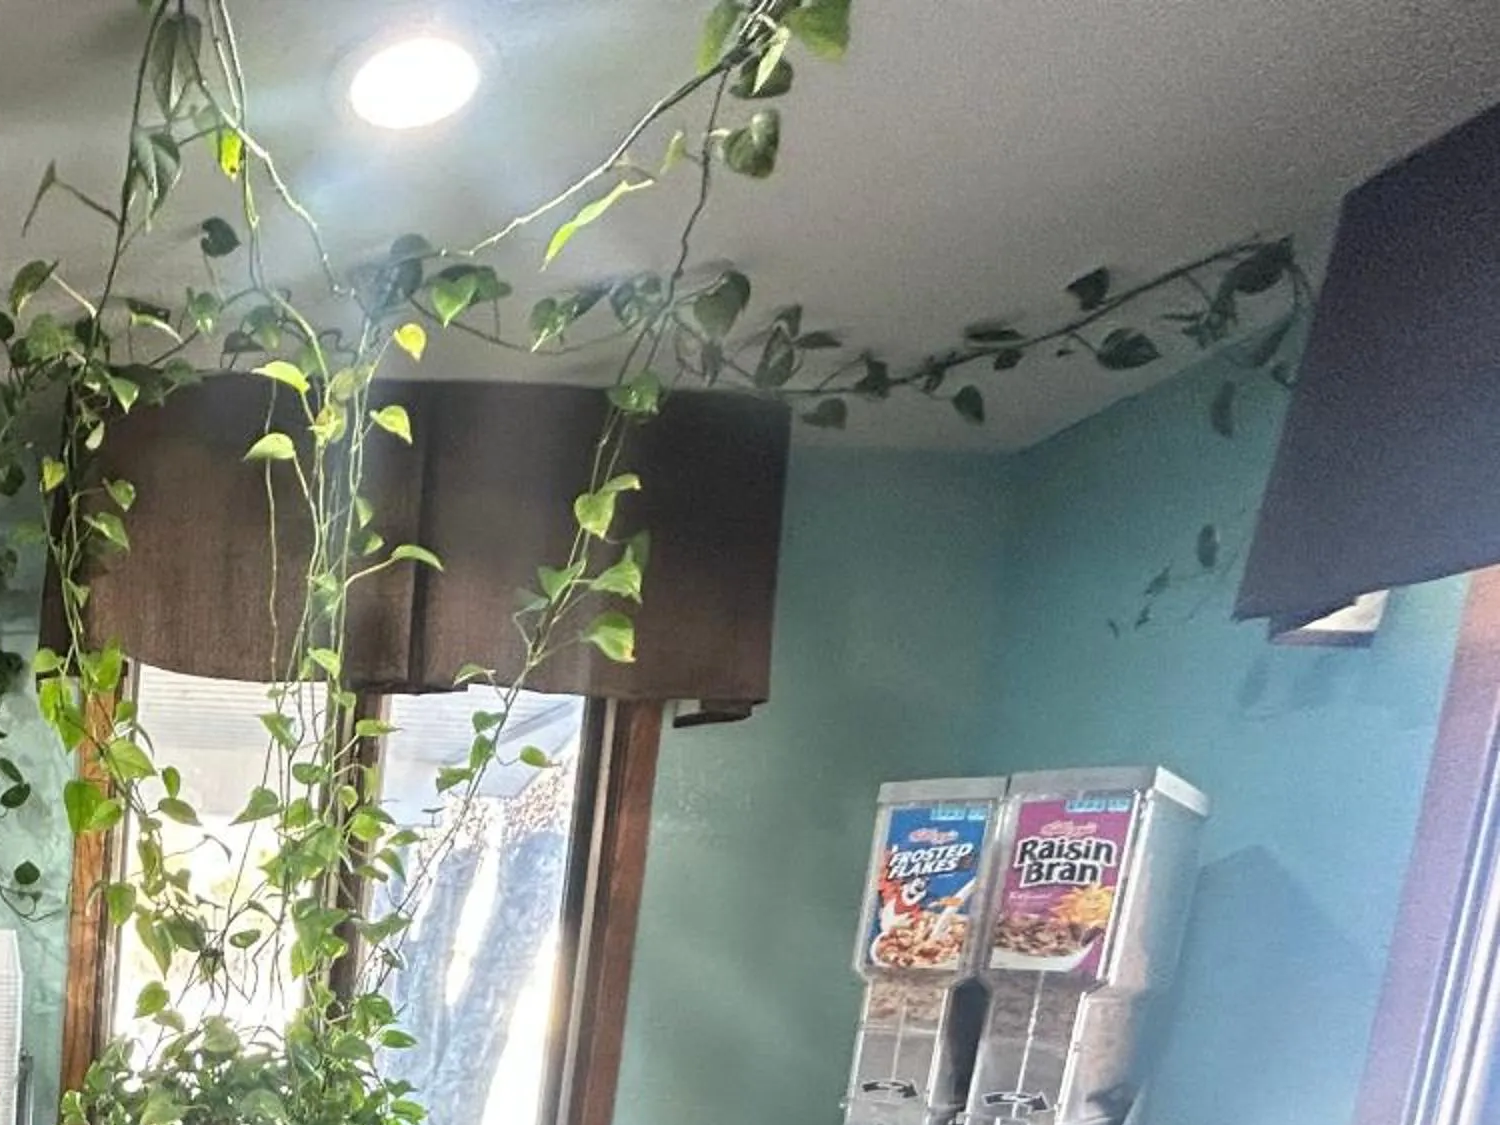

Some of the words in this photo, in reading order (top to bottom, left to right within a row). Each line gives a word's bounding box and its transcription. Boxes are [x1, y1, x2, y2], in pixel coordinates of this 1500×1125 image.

[888, 842, 974, 867] FROSTED
[1016, 837, 1115, 866] Raisin
[887, 859, 959, 880] FLAKES
[1022, 861, 1100, 884] Bran
